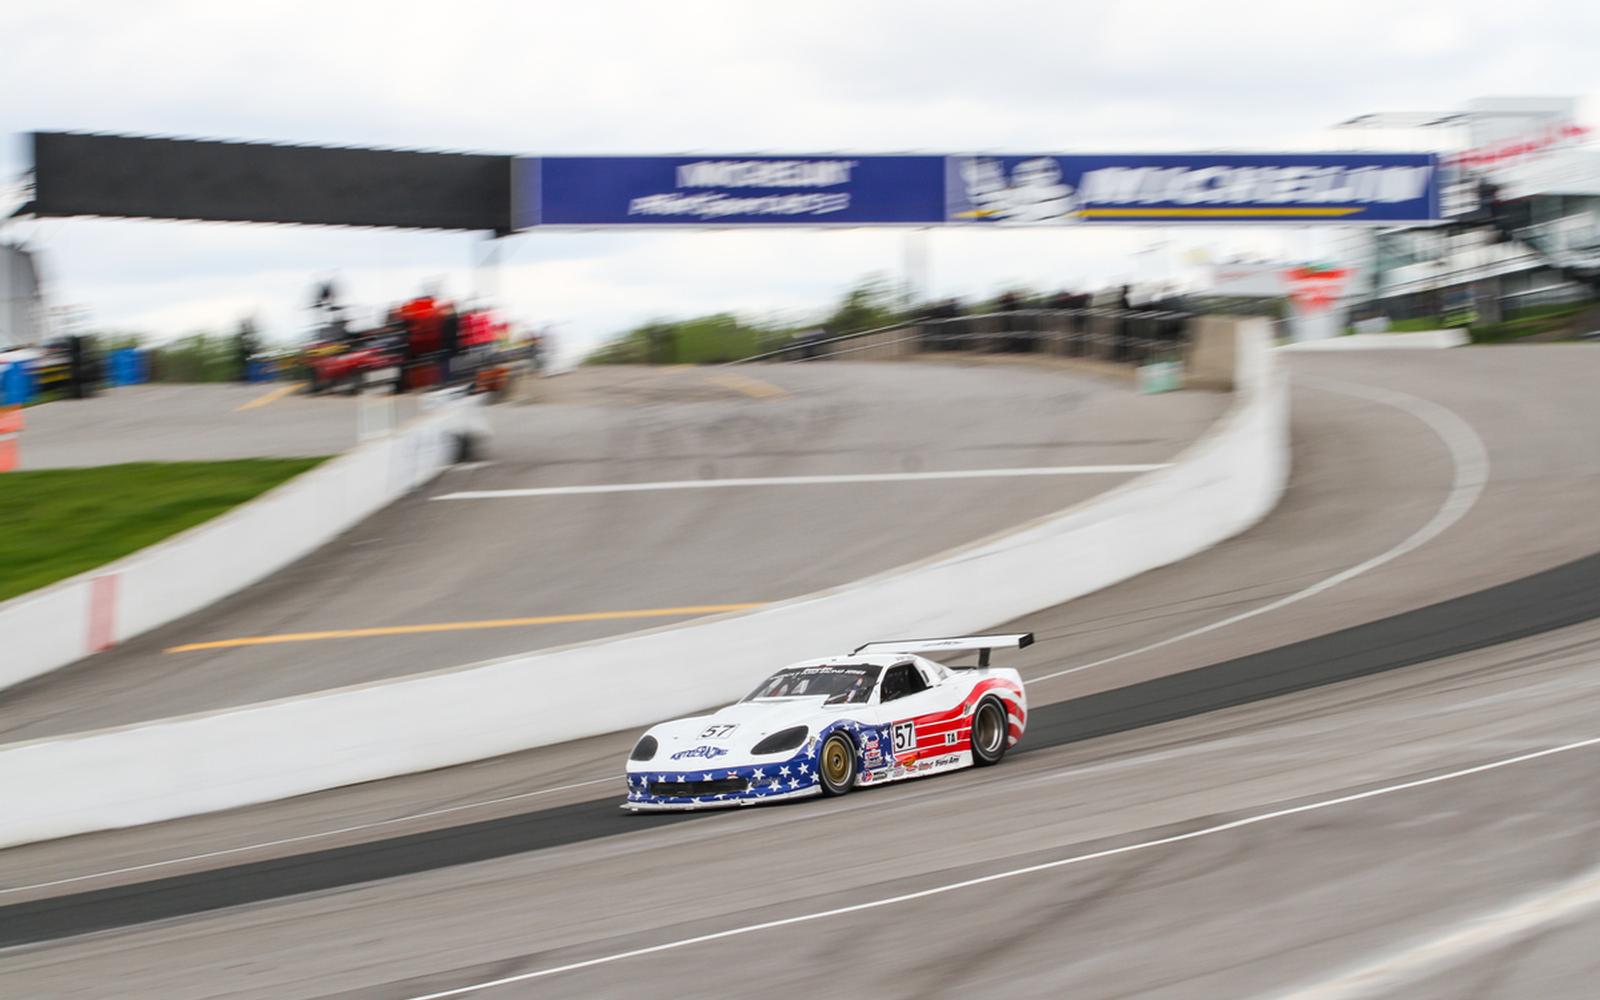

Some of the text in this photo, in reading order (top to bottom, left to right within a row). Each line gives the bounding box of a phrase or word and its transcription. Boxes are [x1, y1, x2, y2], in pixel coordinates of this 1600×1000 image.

[676, 160, 857, 188] MICHELIN
[1081, 165, 1430, 204] MICHELIN
[701, 724, 736, 738] 57
[895, 723, 914, 749] 57
[947, 733, 956, 744] TA
